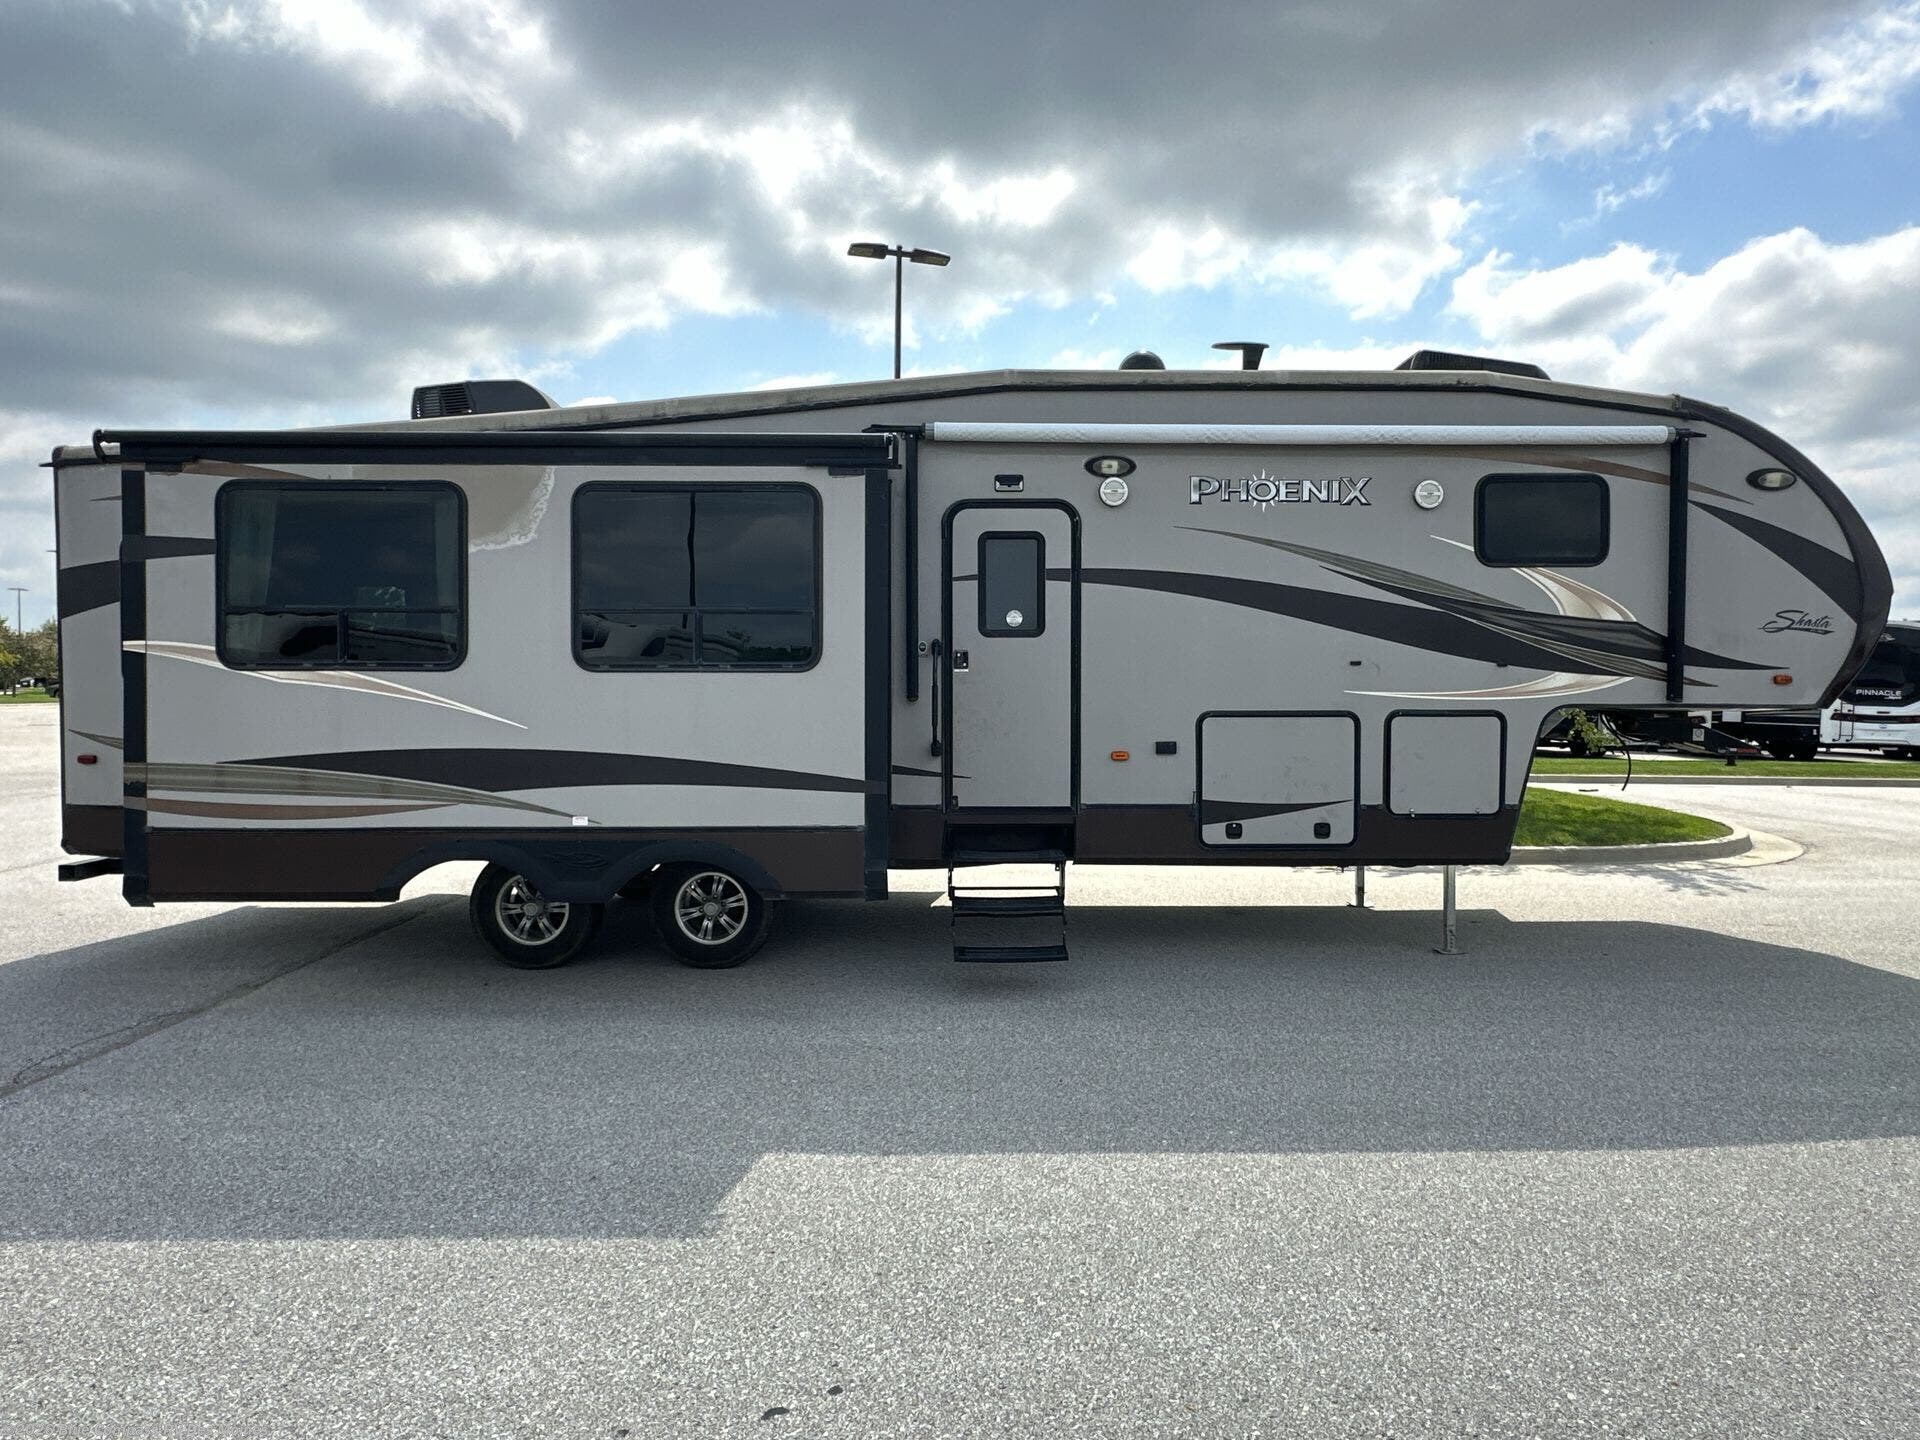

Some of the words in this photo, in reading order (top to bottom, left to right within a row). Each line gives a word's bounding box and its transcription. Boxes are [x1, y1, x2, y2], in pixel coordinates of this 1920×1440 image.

[1189, 474, 1372, 506] PHOENIX
[1760, 609, 1833, 634] Shasta
[1855, 689, 1902, 697] PINNACLE
